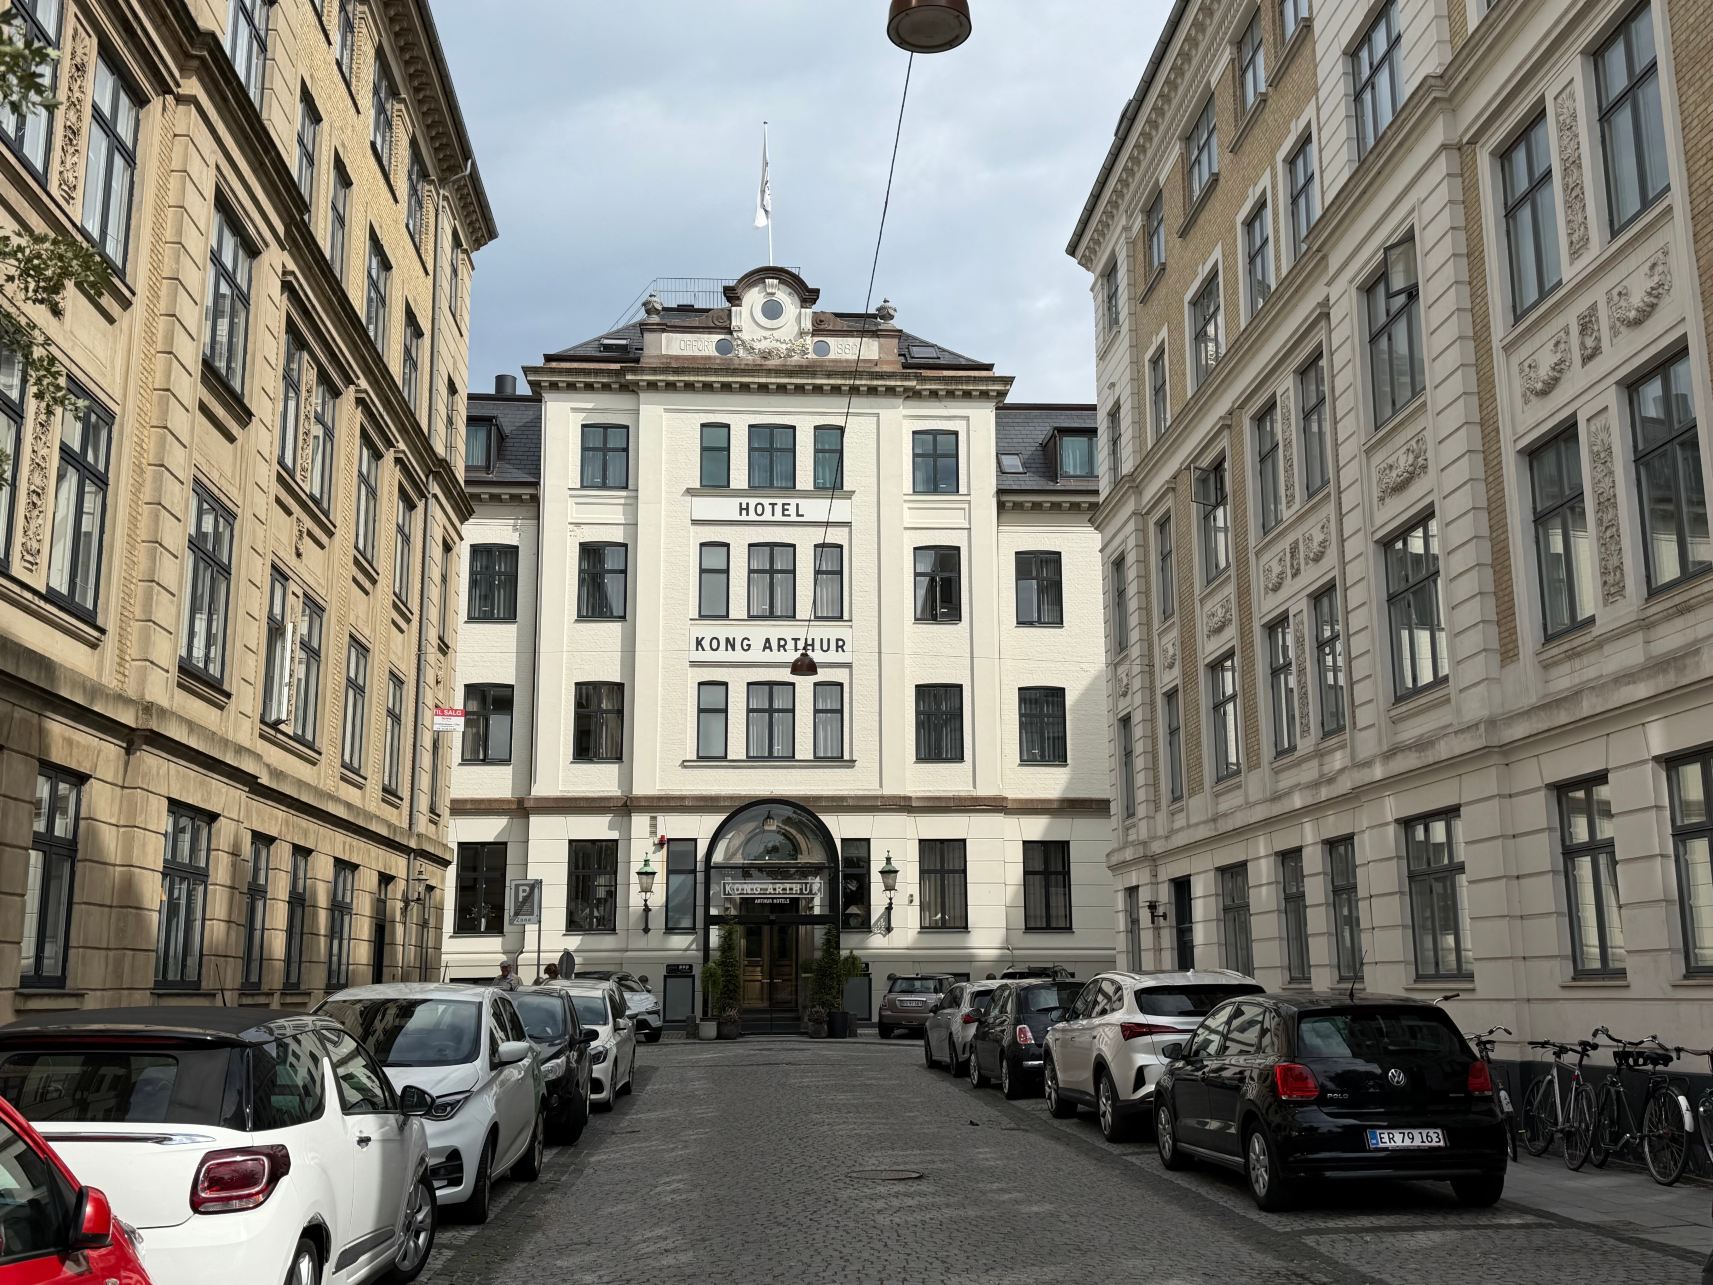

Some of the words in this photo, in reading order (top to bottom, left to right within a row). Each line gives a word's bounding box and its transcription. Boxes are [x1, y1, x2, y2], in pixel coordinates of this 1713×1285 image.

[738, 501, 805, 518] HOTEL
[695, 636, 752, 652] KONG
[761, 637, 847, 653] ARTHUR
[725, 883, 761, 895] KONG
[767, 883, 820, 895] ARTHUR
[1378, 1131, 1397, 1144] ER
[1398, 1131, 1415, 1144] 79
[1418, 1130, 1442, 1144] 163
